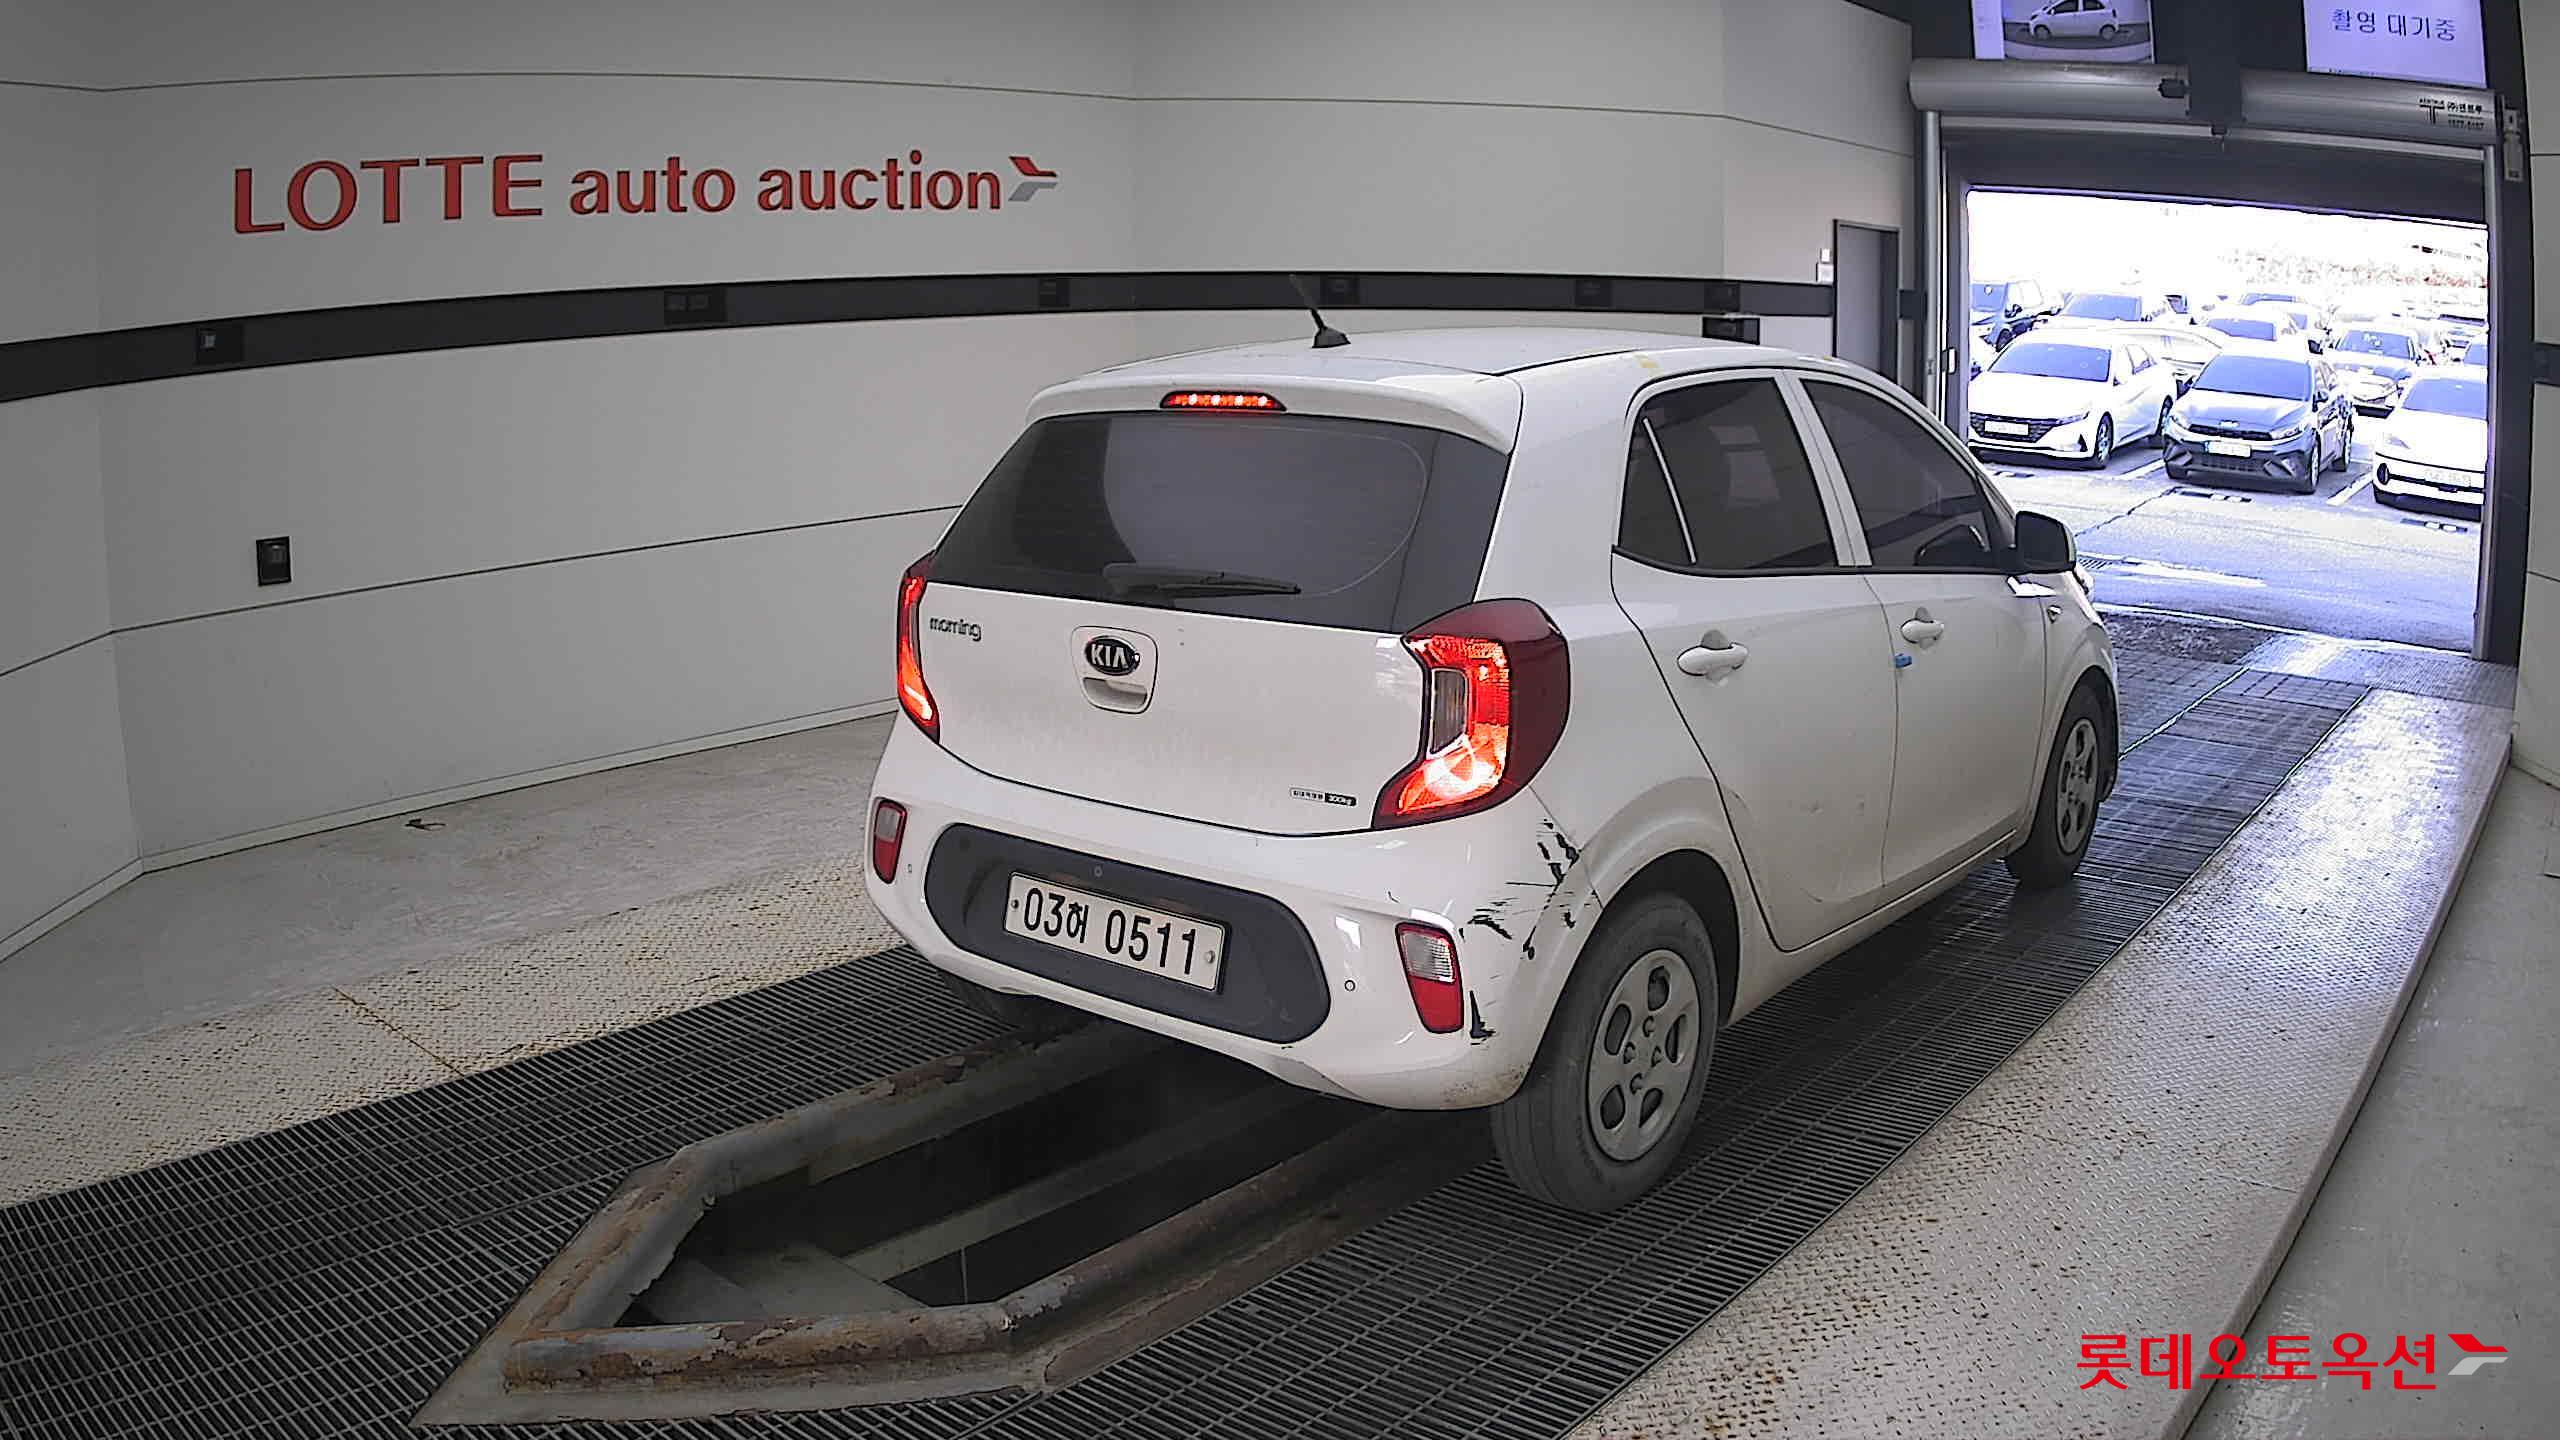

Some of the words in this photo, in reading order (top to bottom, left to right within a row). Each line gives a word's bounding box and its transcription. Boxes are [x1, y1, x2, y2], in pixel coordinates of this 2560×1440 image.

[2331, 8, 2376, 34] 촬영
[2387, 13, 2457, 42] 대기중
[234, 154, 543, 234] LOTTE
[569, 156, 736, 215] auto
[757, 149, 1001, 212] auction
[930, 617, 981, 642] morning
[1090, 642, 1129, 669] KIA
[1023, 887, 1089, 944] 03허
[1105, 909, 1197, 975] 0511
